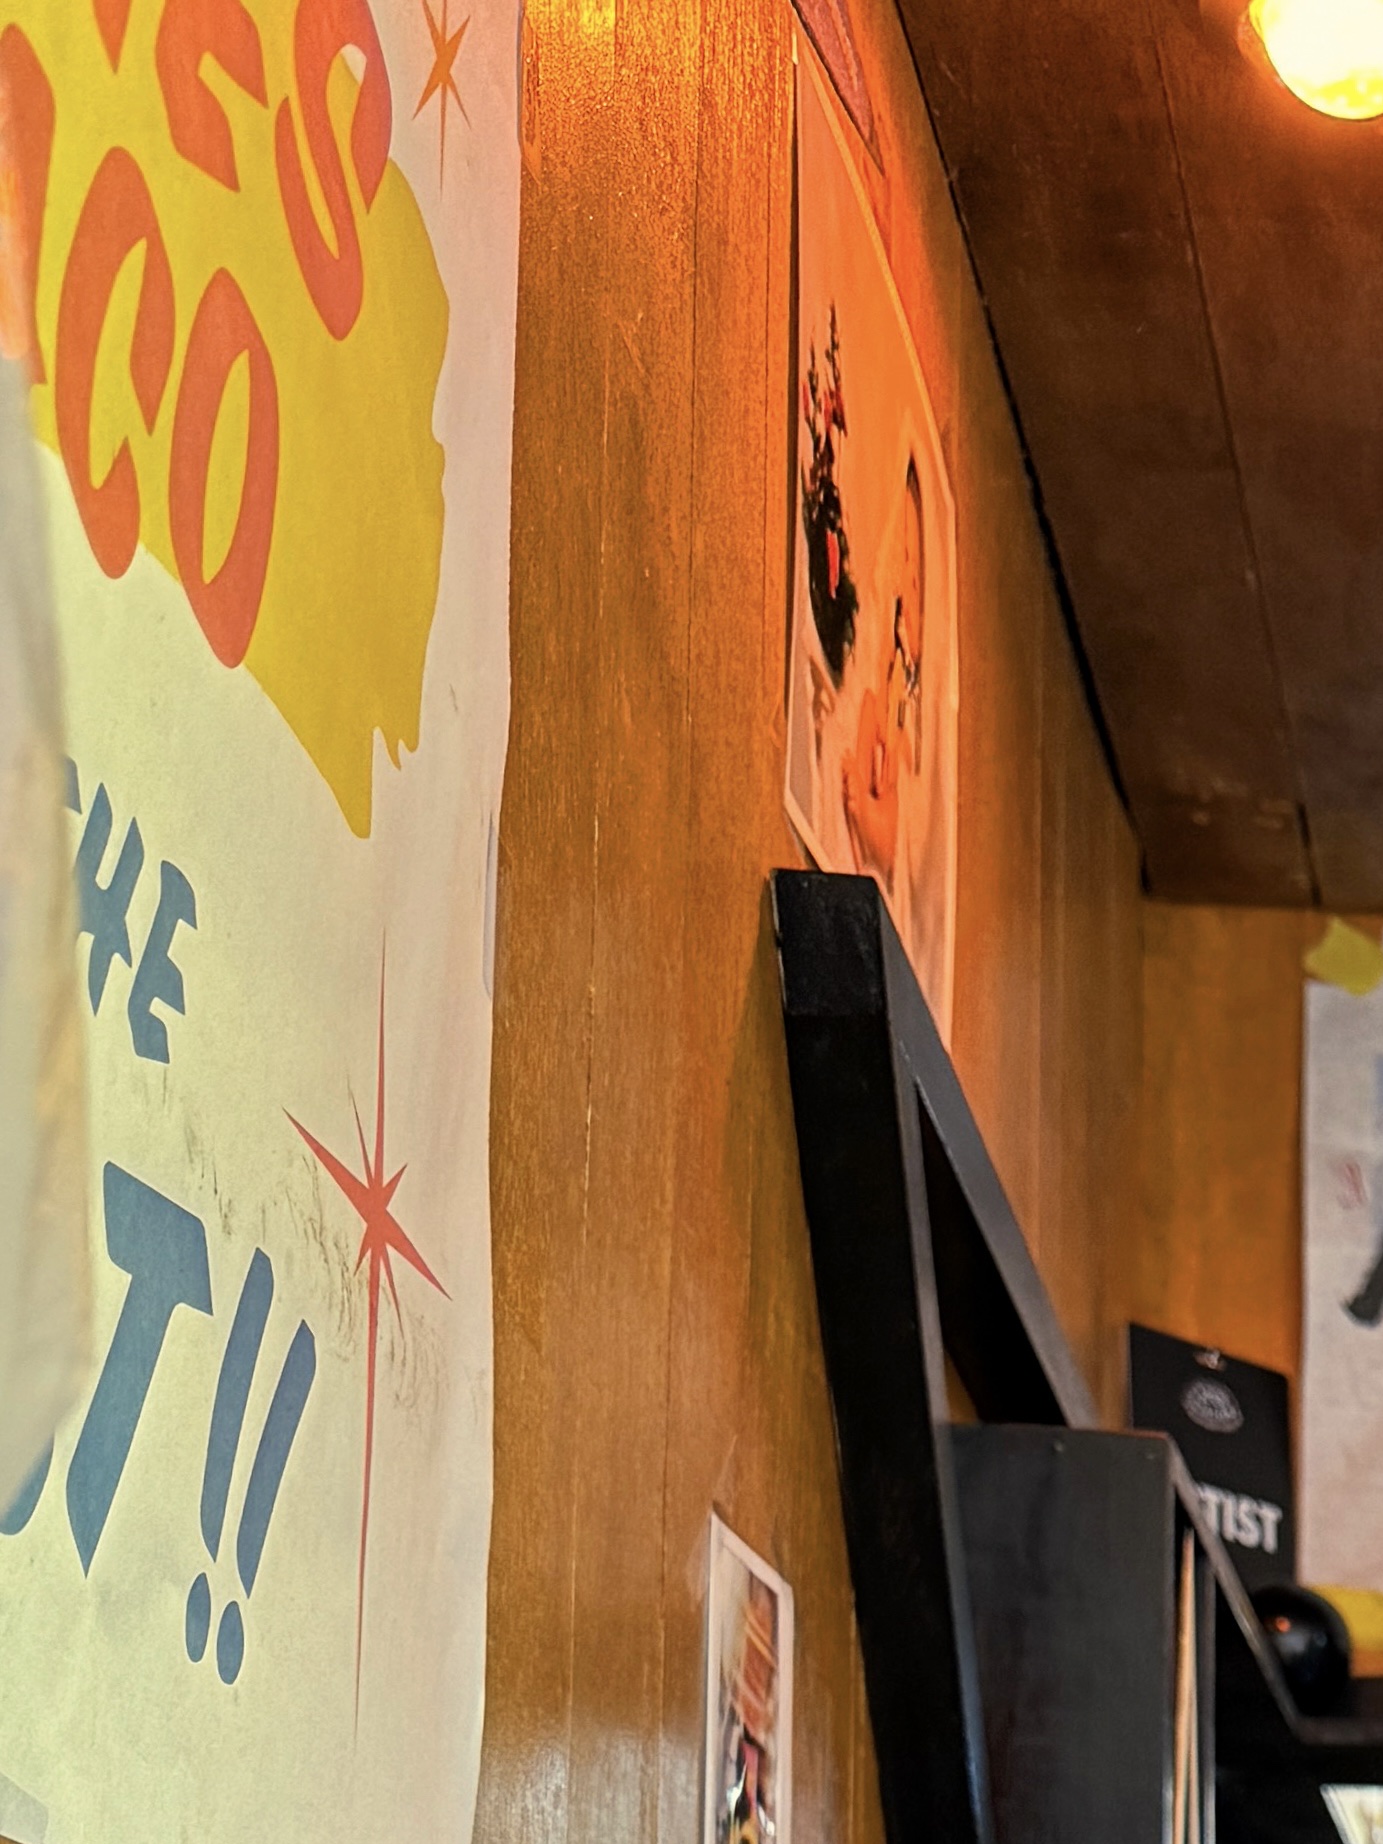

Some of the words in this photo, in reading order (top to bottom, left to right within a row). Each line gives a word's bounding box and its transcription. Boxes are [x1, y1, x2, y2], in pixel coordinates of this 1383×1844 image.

[92, 0, 392, 341] ES
[64, 754, 198, 1065] HE
[0, 1160, 317, 1685] T!!
